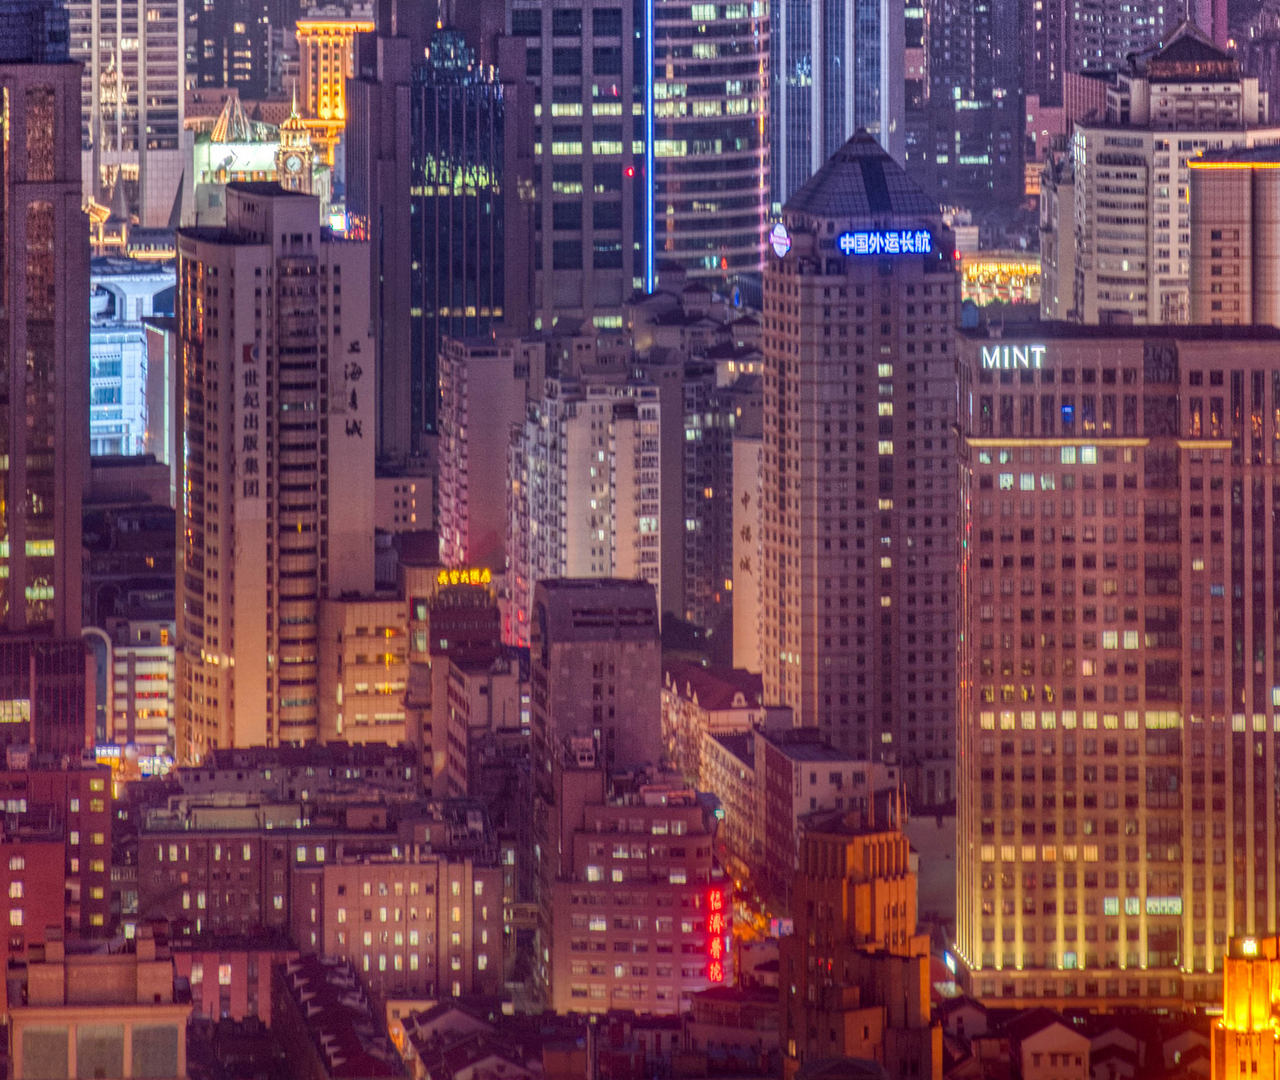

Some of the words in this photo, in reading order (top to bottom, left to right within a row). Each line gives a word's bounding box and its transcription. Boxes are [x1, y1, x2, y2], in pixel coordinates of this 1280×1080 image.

[839, 229, 932, 256] 中国外运长航
[982, 344, 1048, 370] MINT
